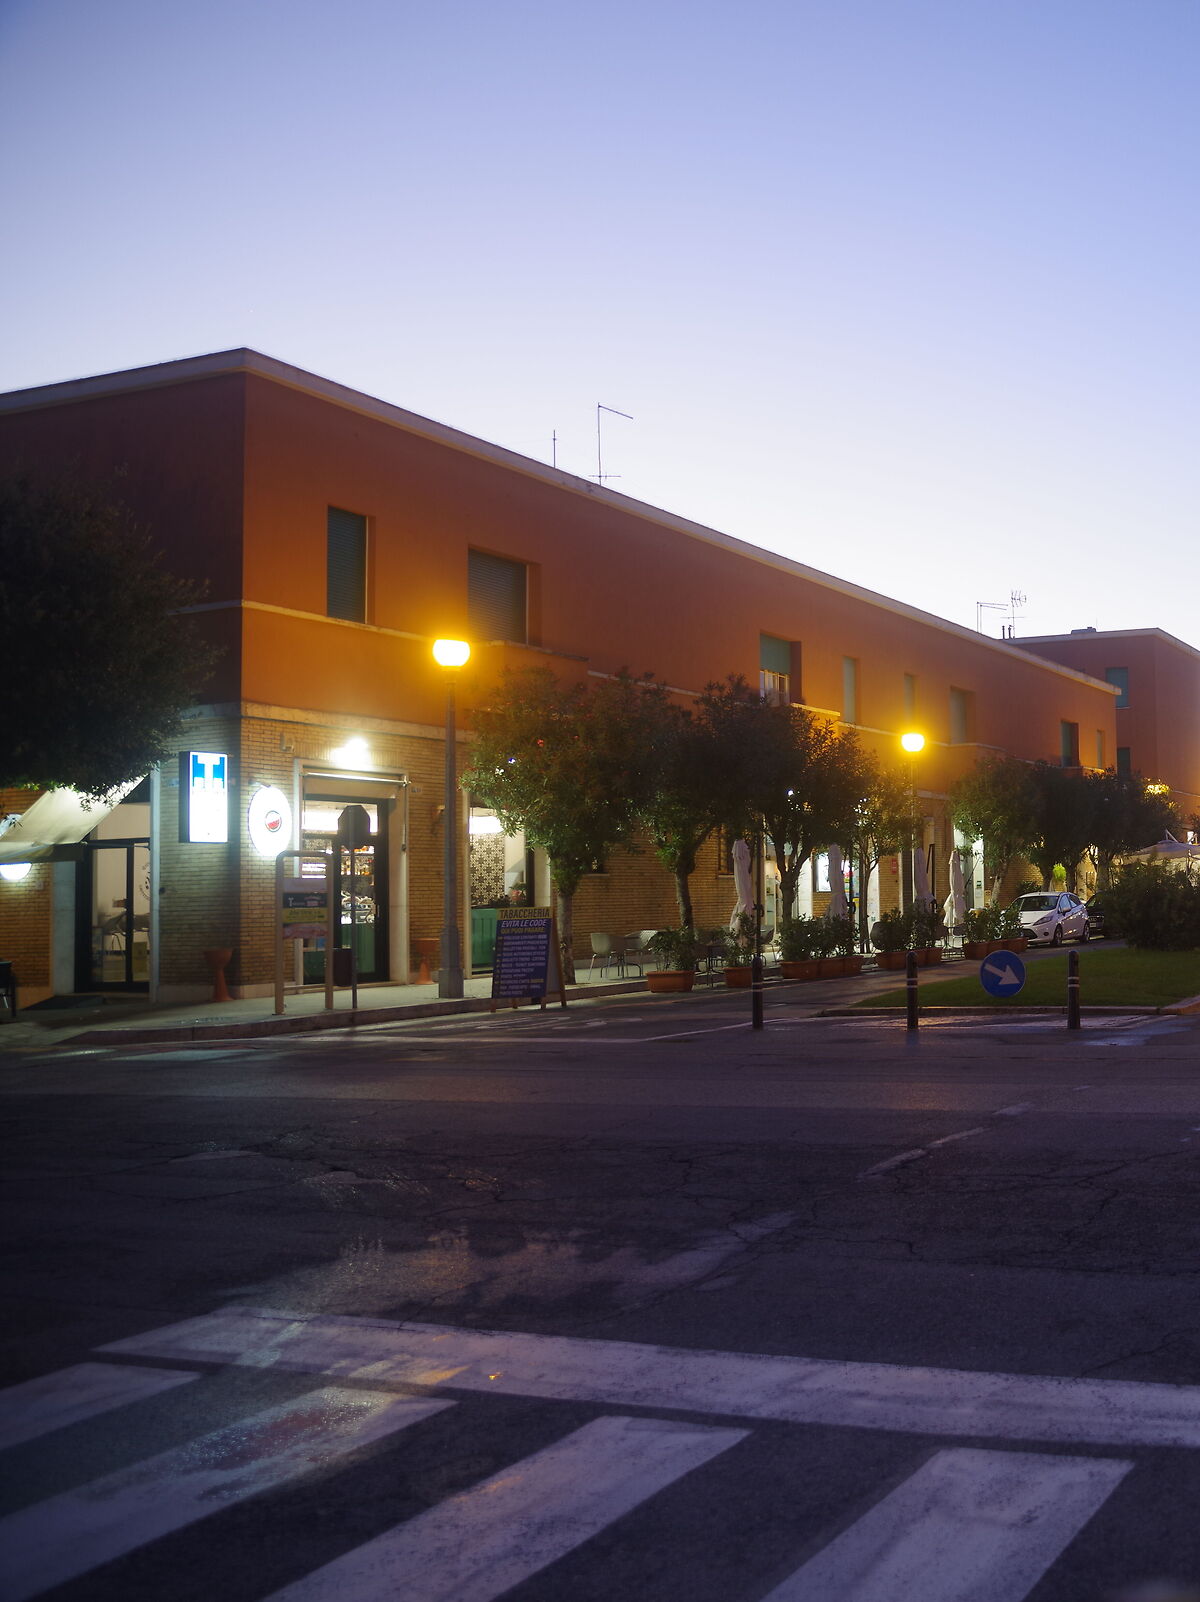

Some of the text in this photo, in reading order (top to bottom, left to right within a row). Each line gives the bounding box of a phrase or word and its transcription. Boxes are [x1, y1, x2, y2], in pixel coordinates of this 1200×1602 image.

[500, 908, 550, 919] TABACCHERIA
[501, 920, 519, 928] EVITA
[529, 919, 547, 927] CODE
